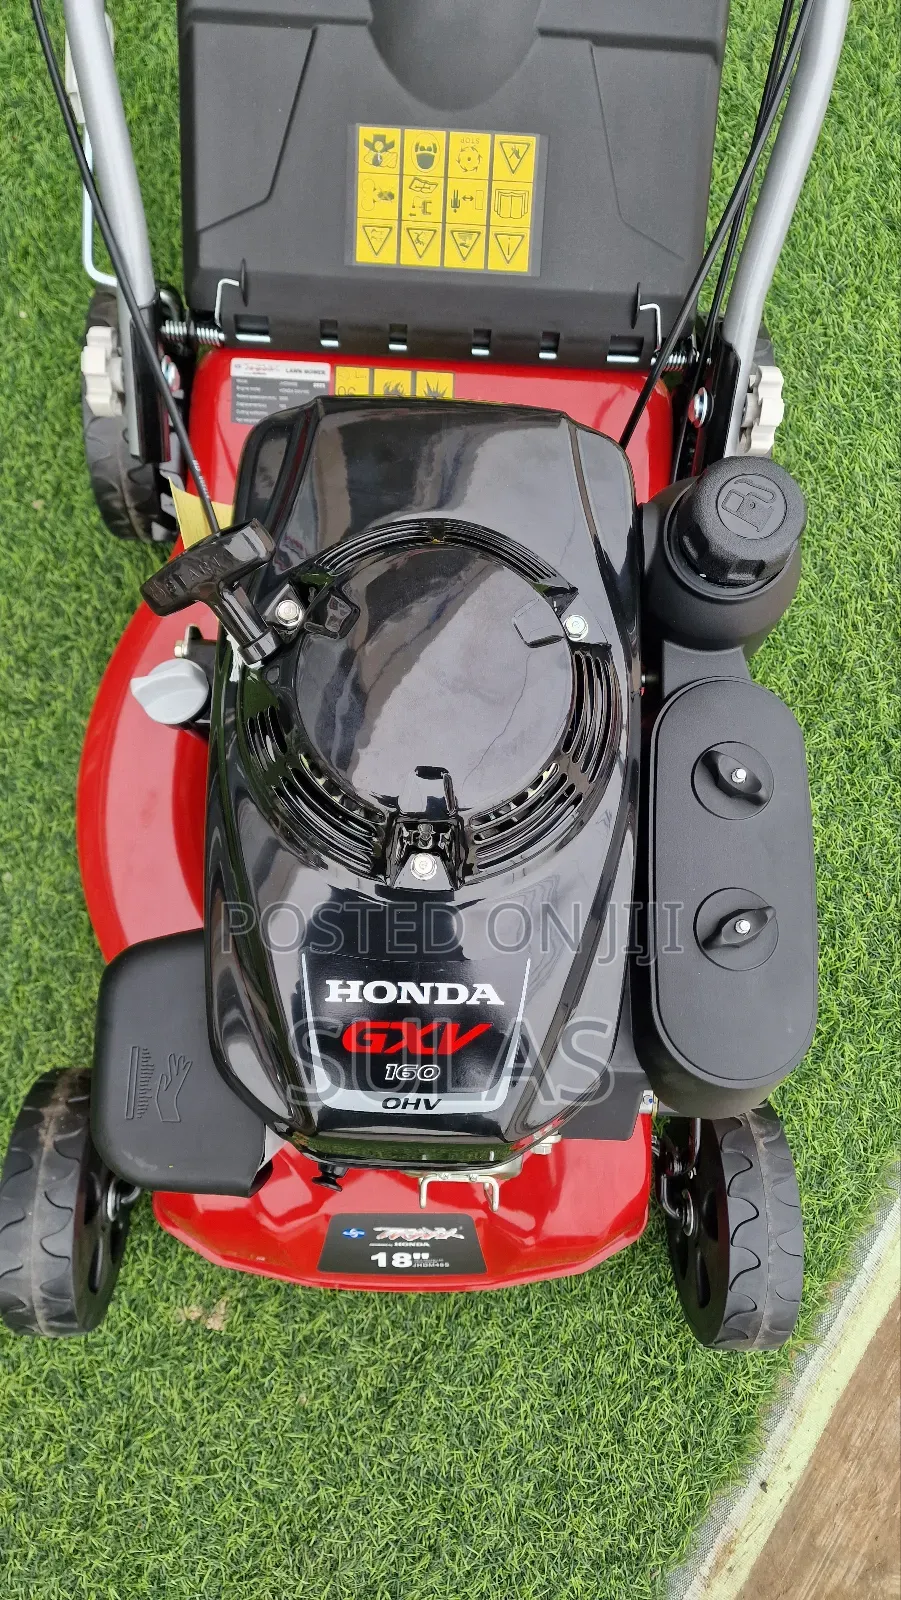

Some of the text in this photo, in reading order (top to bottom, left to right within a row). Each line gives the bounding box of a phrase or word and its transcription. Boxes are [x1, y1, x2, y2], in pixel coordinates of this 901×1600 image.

[460, 136, 480, 145] STOP
[325, 980, 504, 1005] HONDA
[342, 1021, 493, 1056] GXV
[385, 1063, 441, 1081] 160
[382, 1097, 442, 1110] OHV
[370, 1251, 430, 1268] 18"
